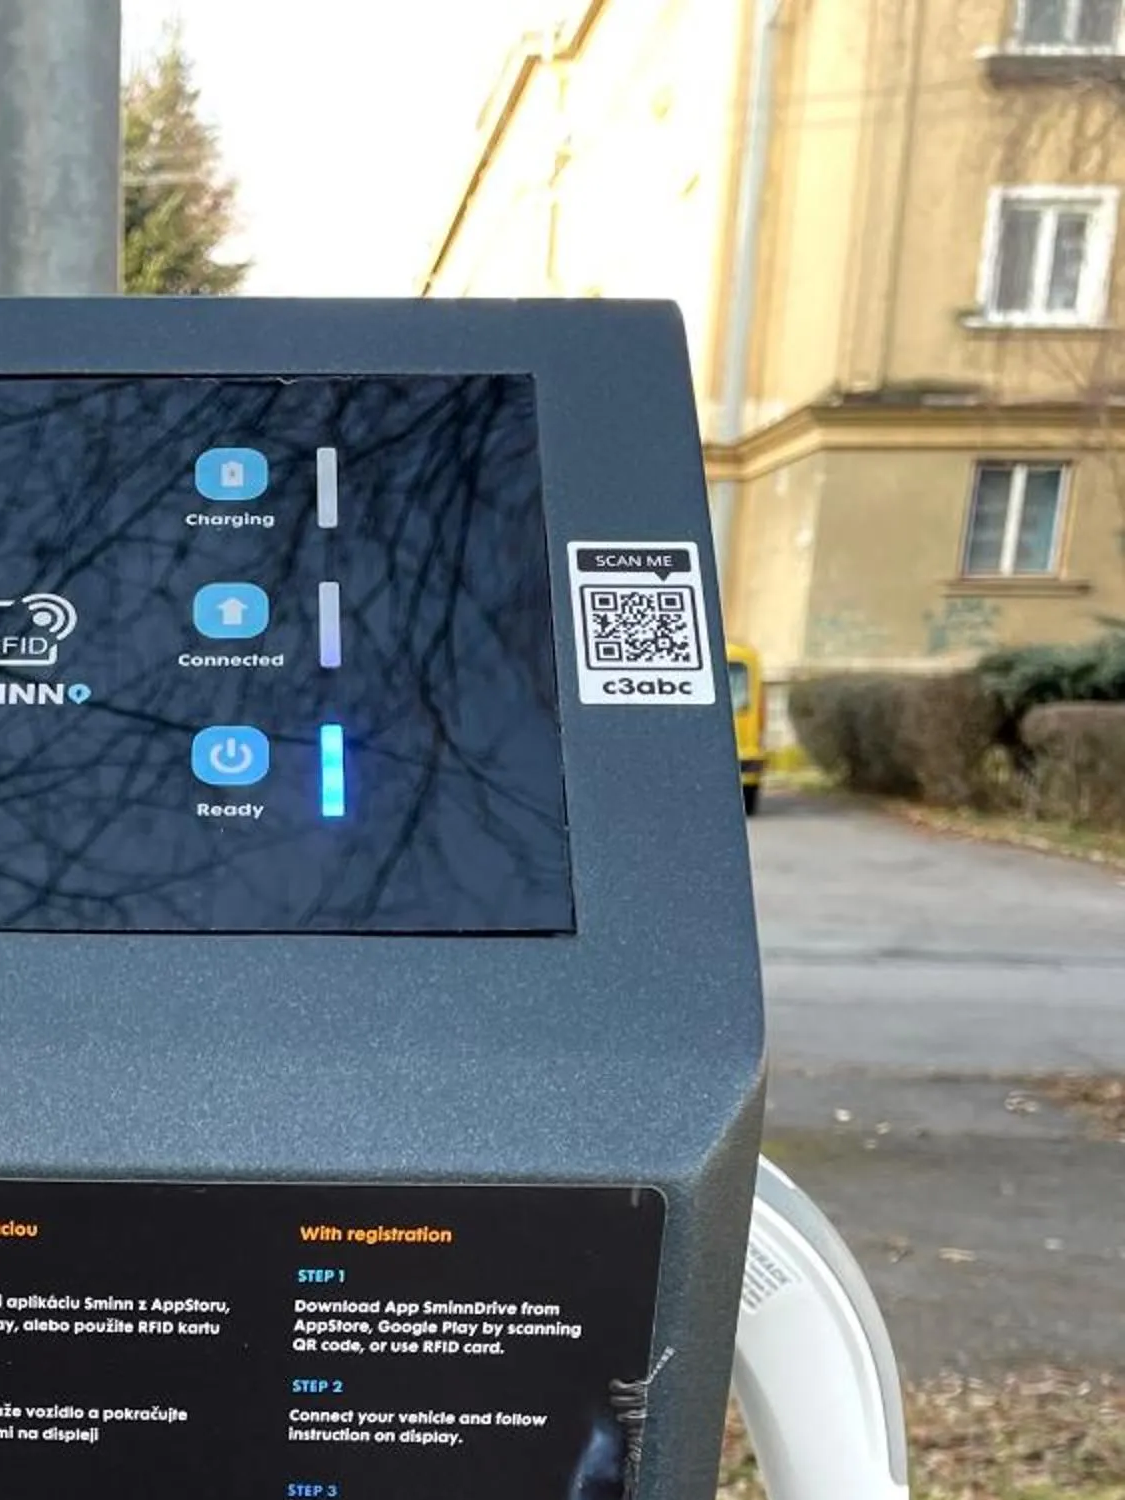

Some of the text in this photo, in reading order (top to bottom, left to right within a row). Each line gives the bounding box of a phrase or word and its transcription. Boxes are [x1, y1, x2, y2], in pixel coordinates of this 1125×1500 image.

[184, 511, 275, 529] Charging
[594, 554, 673, 568] SCAN ME
[177, 653, 285, 668] Connected
[601, 676, 693, 696] c3abc
[196, 802, 265, 820] Ready
[299, 1224, 453, 1246] With registration
[297, 1268, 345, 1283] STEP 1
[83, 1295, 135, 1312] Sminn
[137, 1299, 148, 1312] z
[150, 1297, 231, 1315] AppStoru,
[293, 1298, 561, 1317] Download App SminnDrive from
[22, 1317, 71, 1333] alebo
[137, 1319, 175, 1335] RFID
[177, 1320, 221, 1336] kartu
[293, 1318, 583, 1340] AppStore, Google Play by scanning
[291, 1337, 505, 1355] QR code, or use RFID card.
[292, 1378, 344, 1394] STEP 2
[288, 1408, 548, 1427] Connect your vehicle and follow
[288, 1426, 464, 1447] instruction on display.
[287, 1483, 338, 1498] STEP 3
